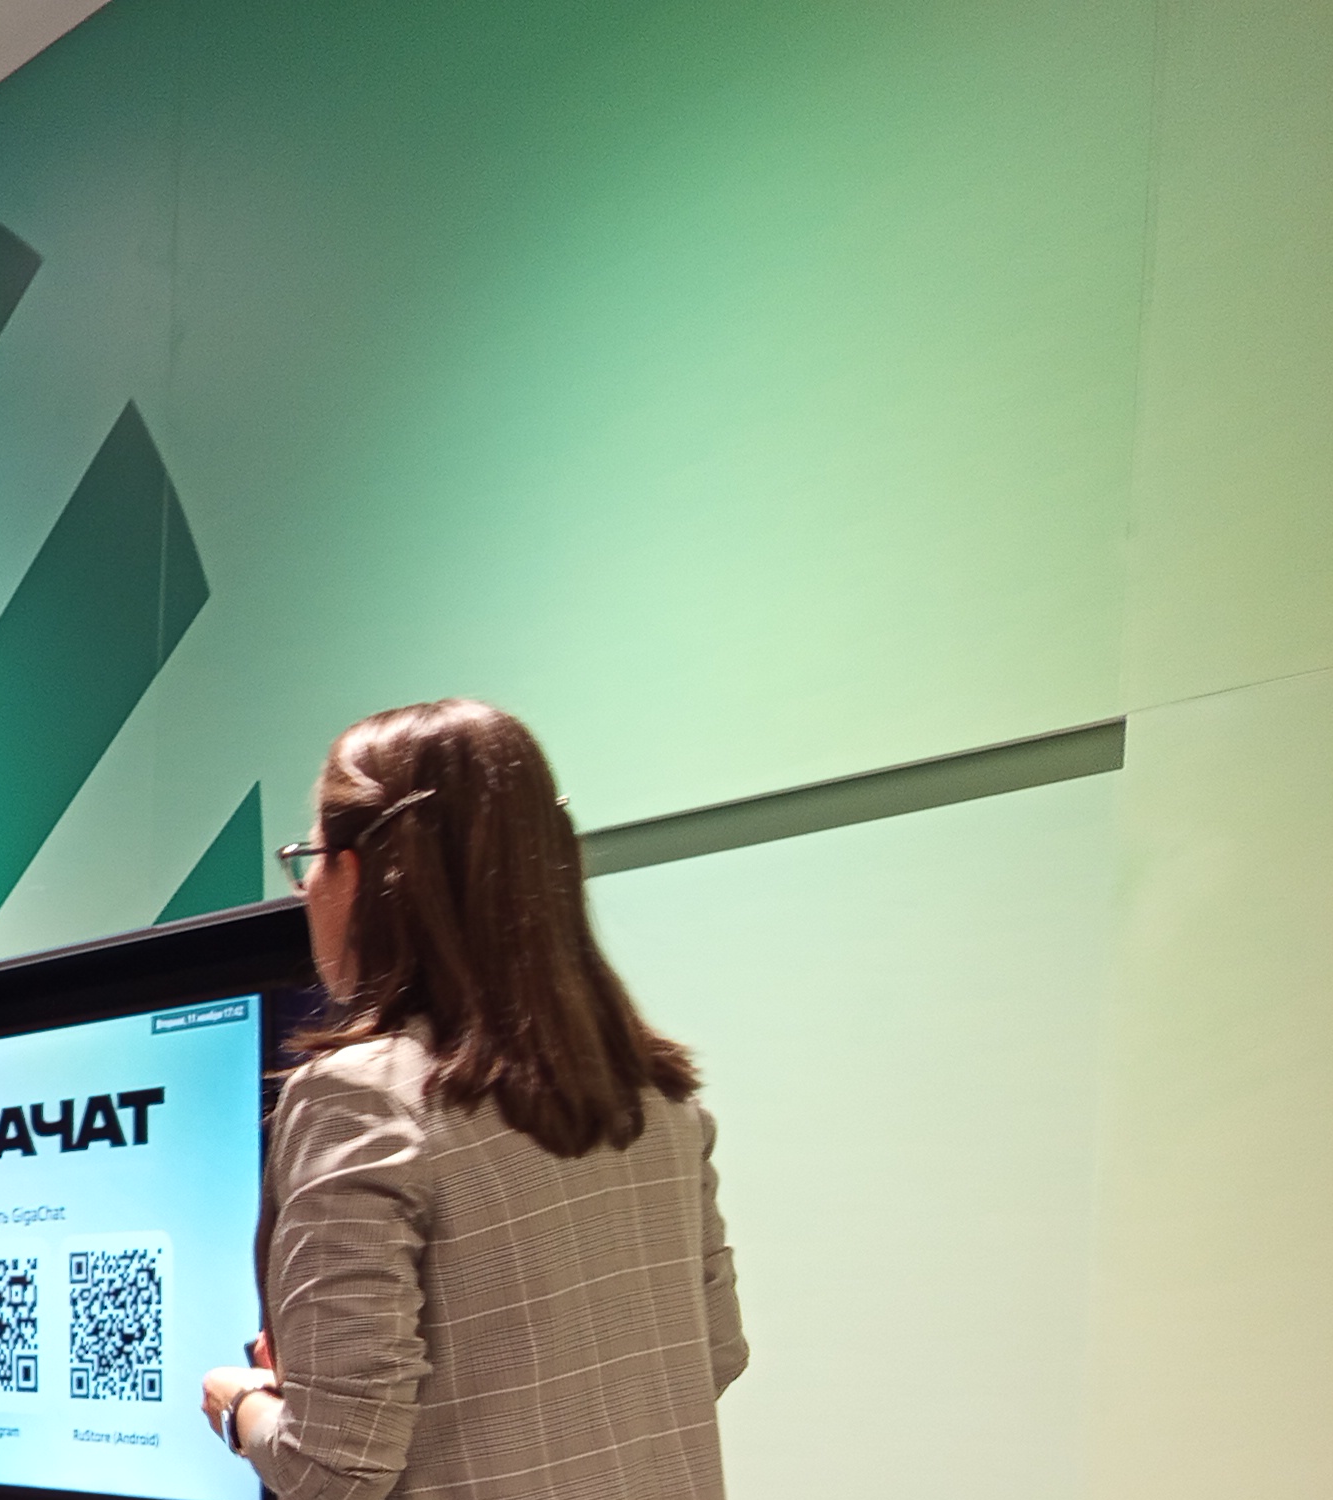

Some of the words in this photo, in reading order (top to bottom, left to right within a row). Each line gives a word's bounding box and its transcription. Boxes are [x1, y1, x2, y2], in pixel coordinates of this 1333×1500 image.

[12, 1205, 66, 1226] GigaChat
[73, 1428, 111, 1444] RuStore
[113, 1430, 160, 1448] (Android)
